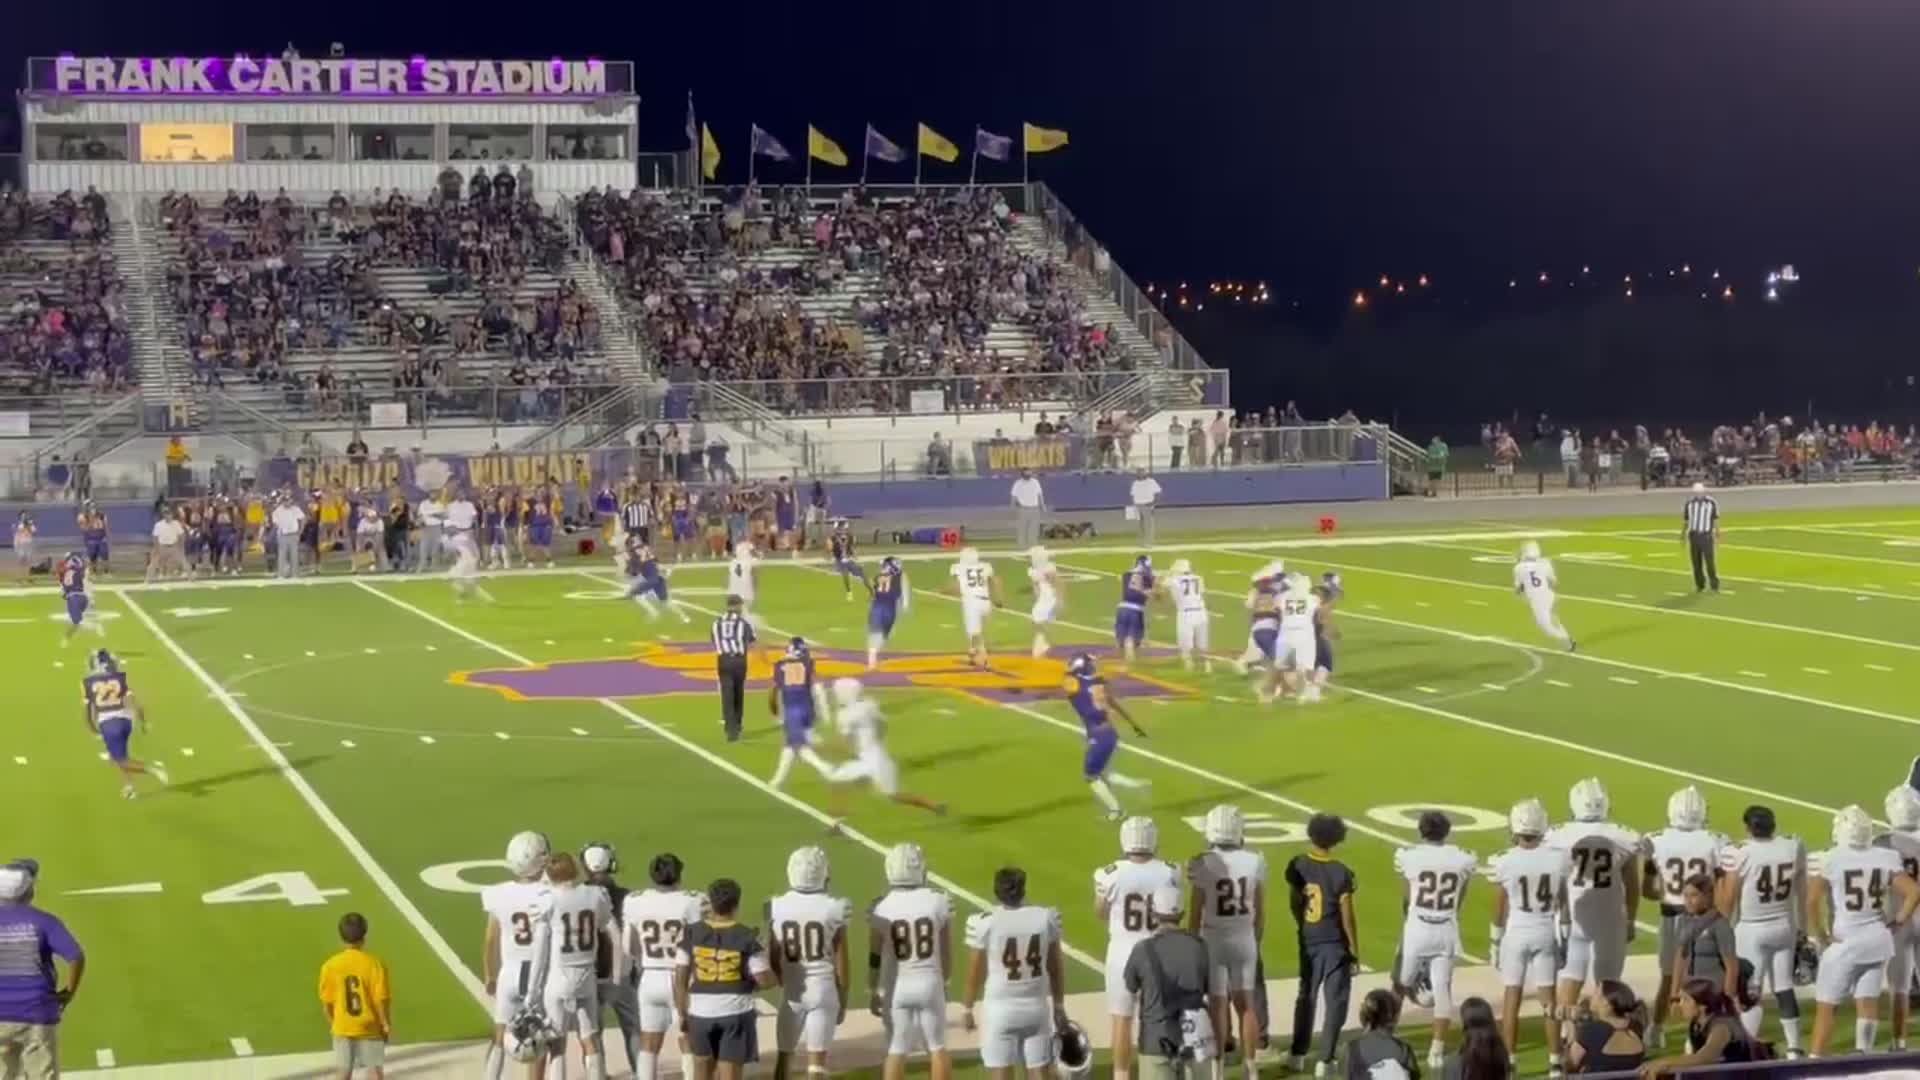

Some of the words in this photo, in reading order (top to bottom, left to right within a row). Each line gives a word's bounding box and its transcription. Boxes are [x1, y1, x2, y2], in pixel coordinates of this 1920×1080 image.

[56, 59, 213, 92] FRANK
[229, 59, 408, 93] CARTER
[422, 61, 606, 93] STADIUM
[93, 678, 123, 706] 22
[1570, 846, 1613, 888] 72
[1755, 862, 1793, 904] 45
[1216, 875, 1250, 917] 21
[1415, 870, 1460, 912] 22
[1517, 873, 1553, 913] 14
[1844, 867, 1883, 912] 54
[511, 911, 533, 946] 3
[560, 909, 596, 953] 10
[781, 920, 825, 964] 80
[892, 917, 934, 962] 88
[693, 946, 742, 984] 52
[1002, 934, 1043, 983] 44
[345, 975, 362, 1017] 6
